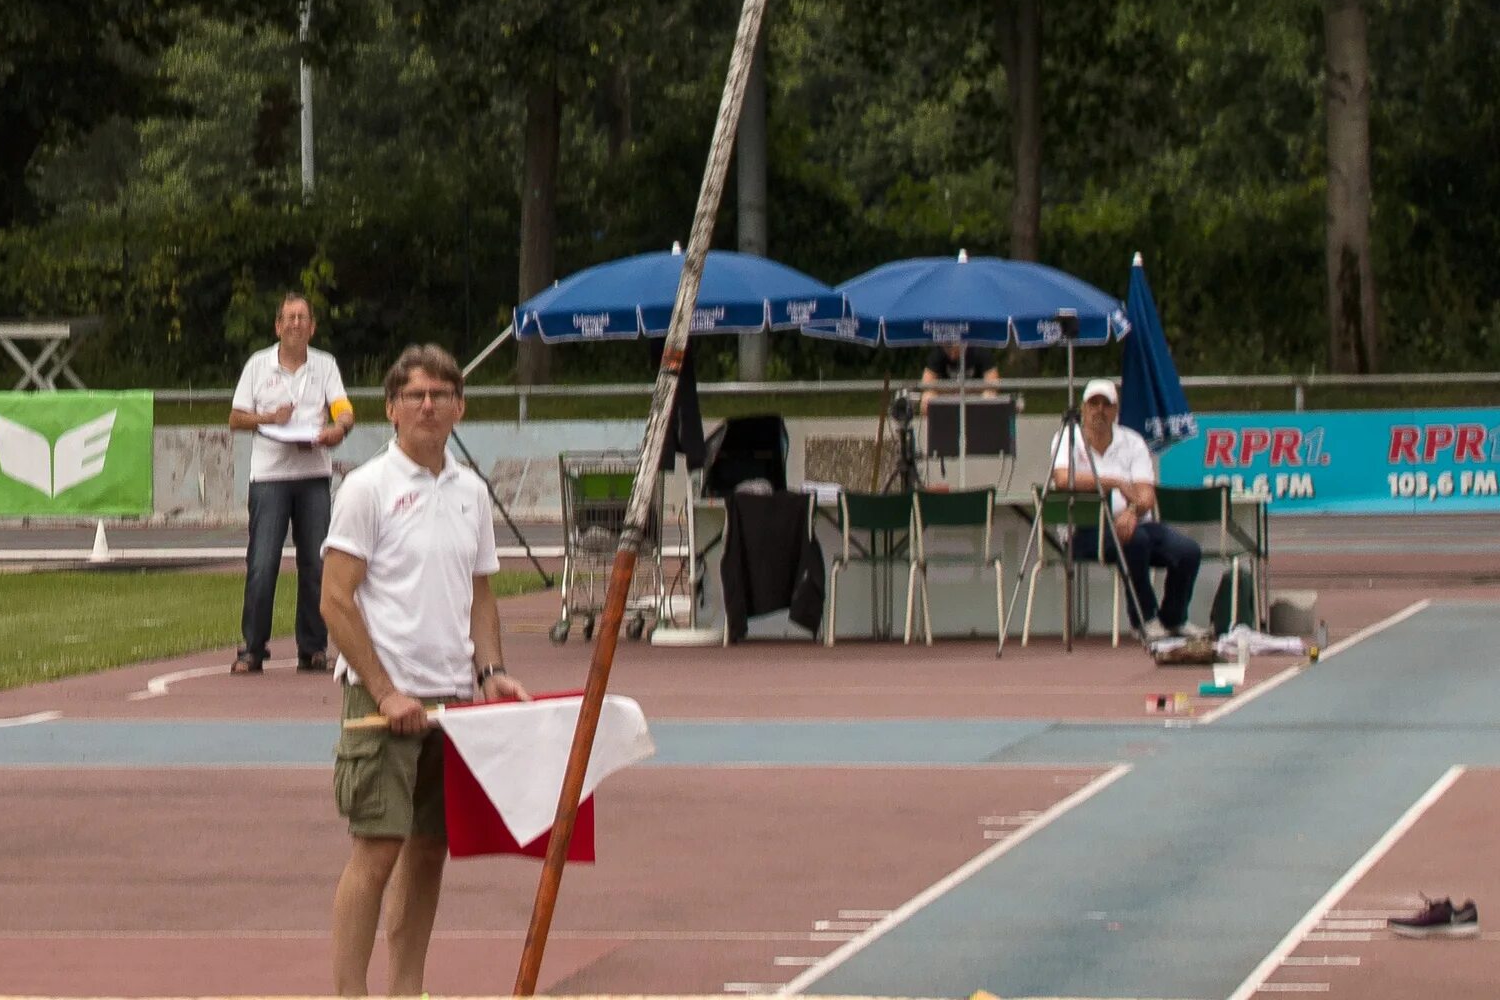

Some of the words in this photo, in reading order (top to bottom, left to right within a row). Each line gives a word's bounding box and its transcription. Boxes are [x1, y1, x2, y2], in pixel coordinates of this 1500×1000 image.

[1276, 472, 1314, 498] FM
[1387, 471, 1453, 501] 103,6
[1461, 470, 1498, 496] FM
